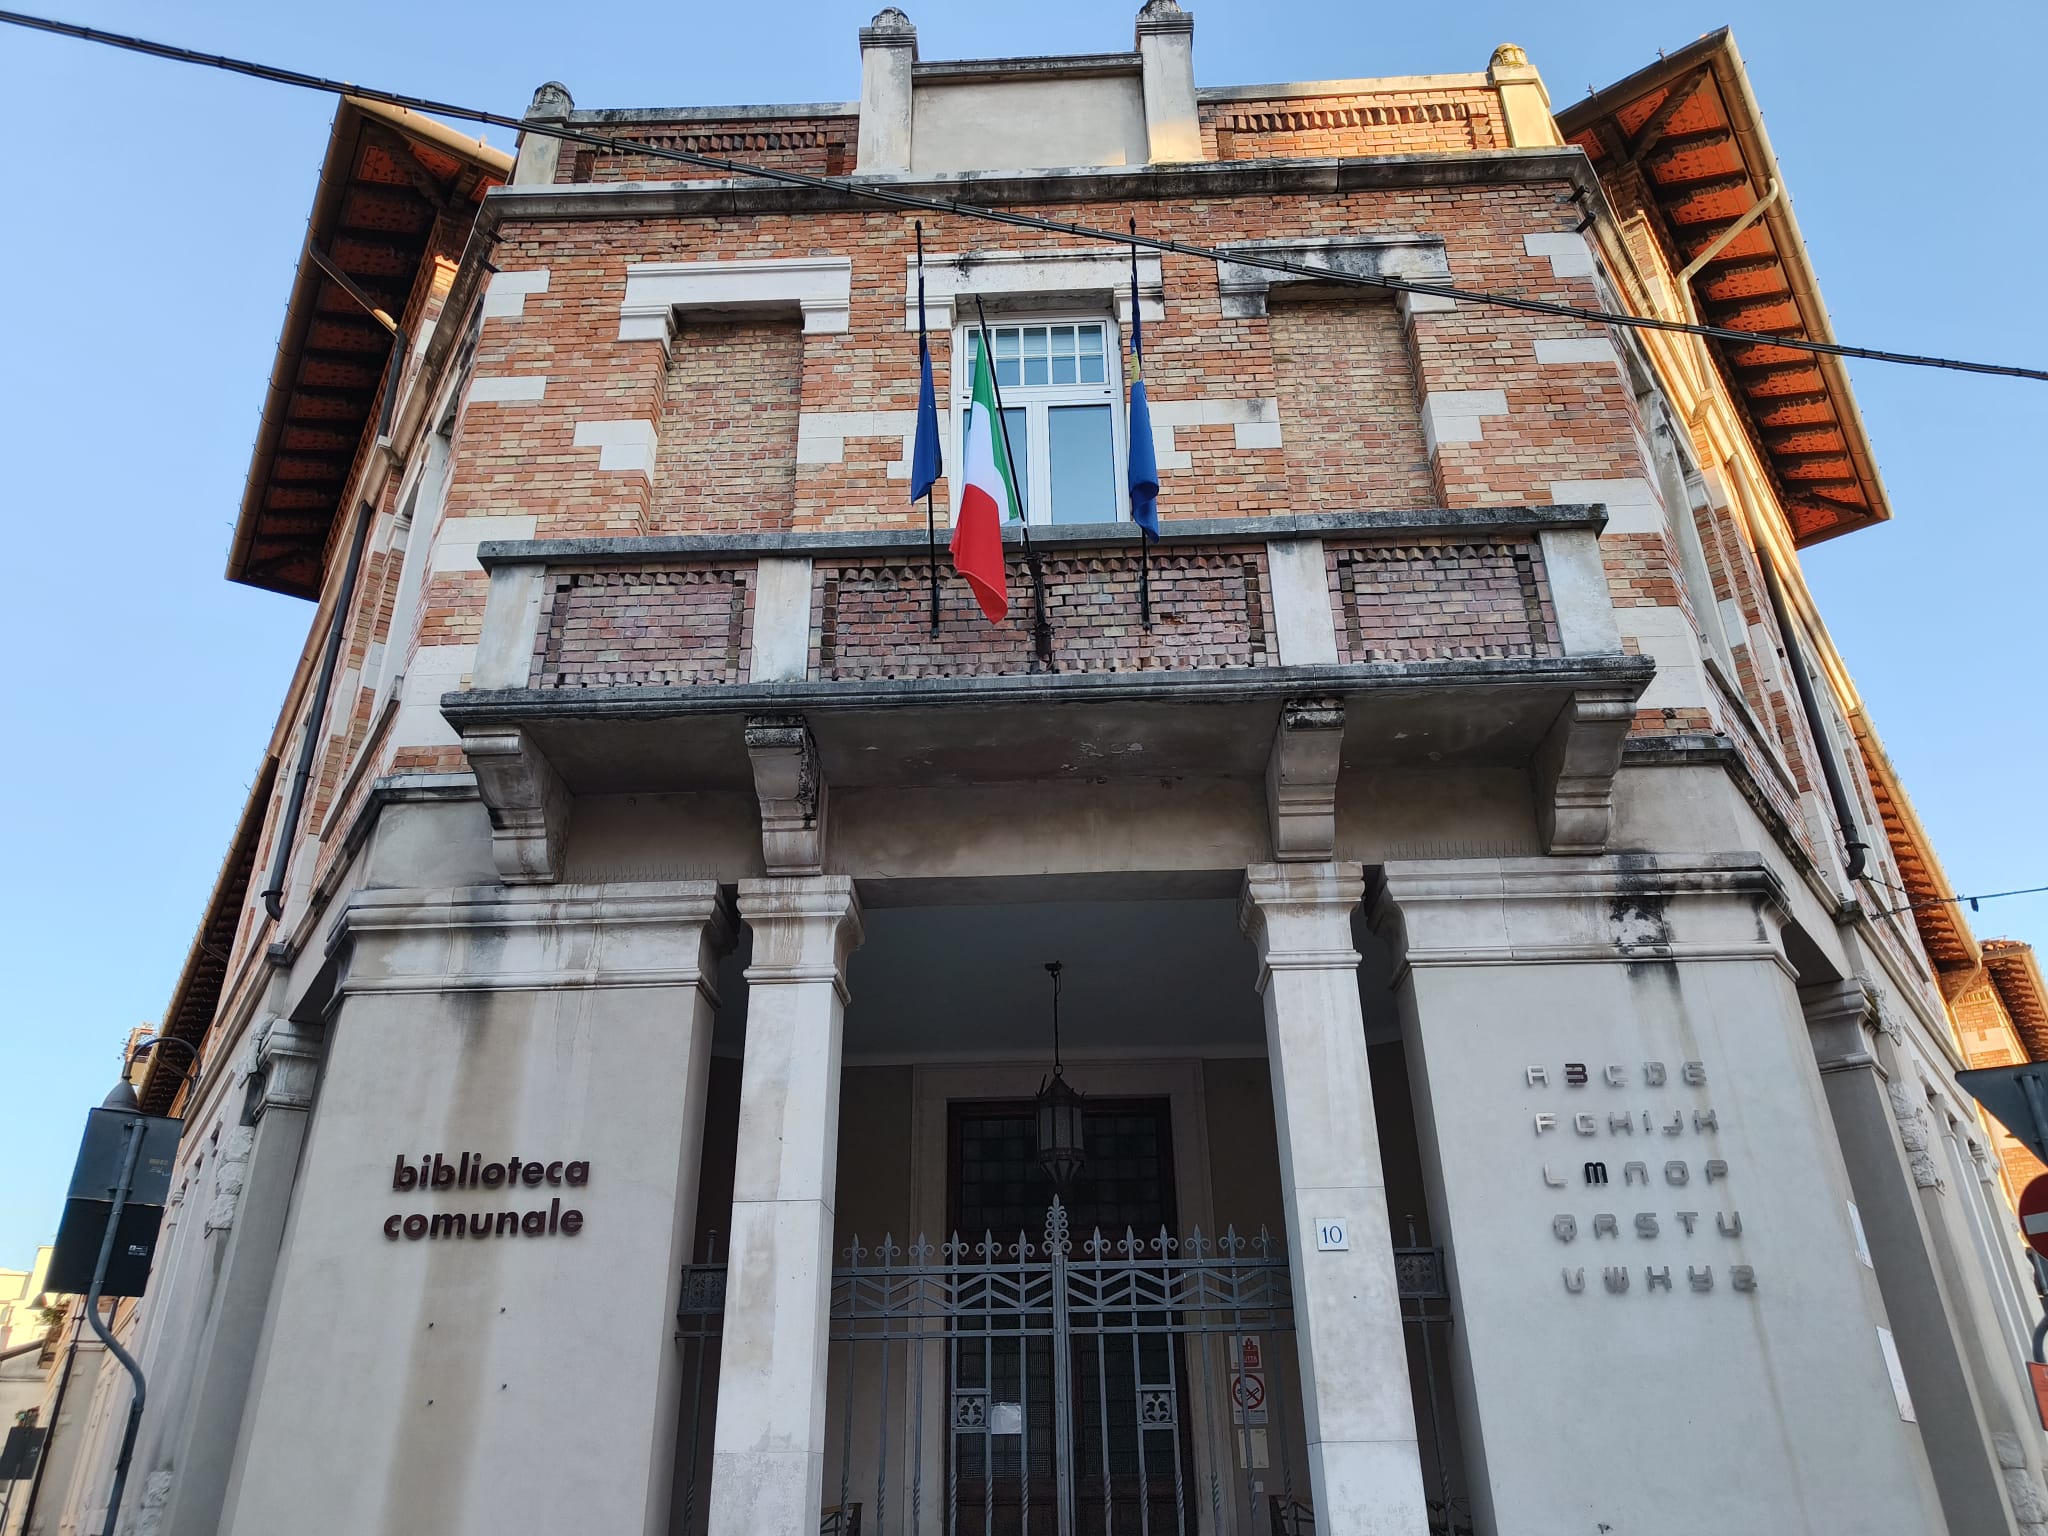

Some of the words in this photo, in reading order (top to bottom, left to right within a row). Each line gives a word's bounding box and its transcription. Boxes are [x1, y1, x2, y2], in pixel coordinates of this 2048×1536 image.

[393, 1152, 590, 1188] biblioteca
[384, 1198, 584, 1238] comunale
[1321, 1225, 1342, 1244] 10
